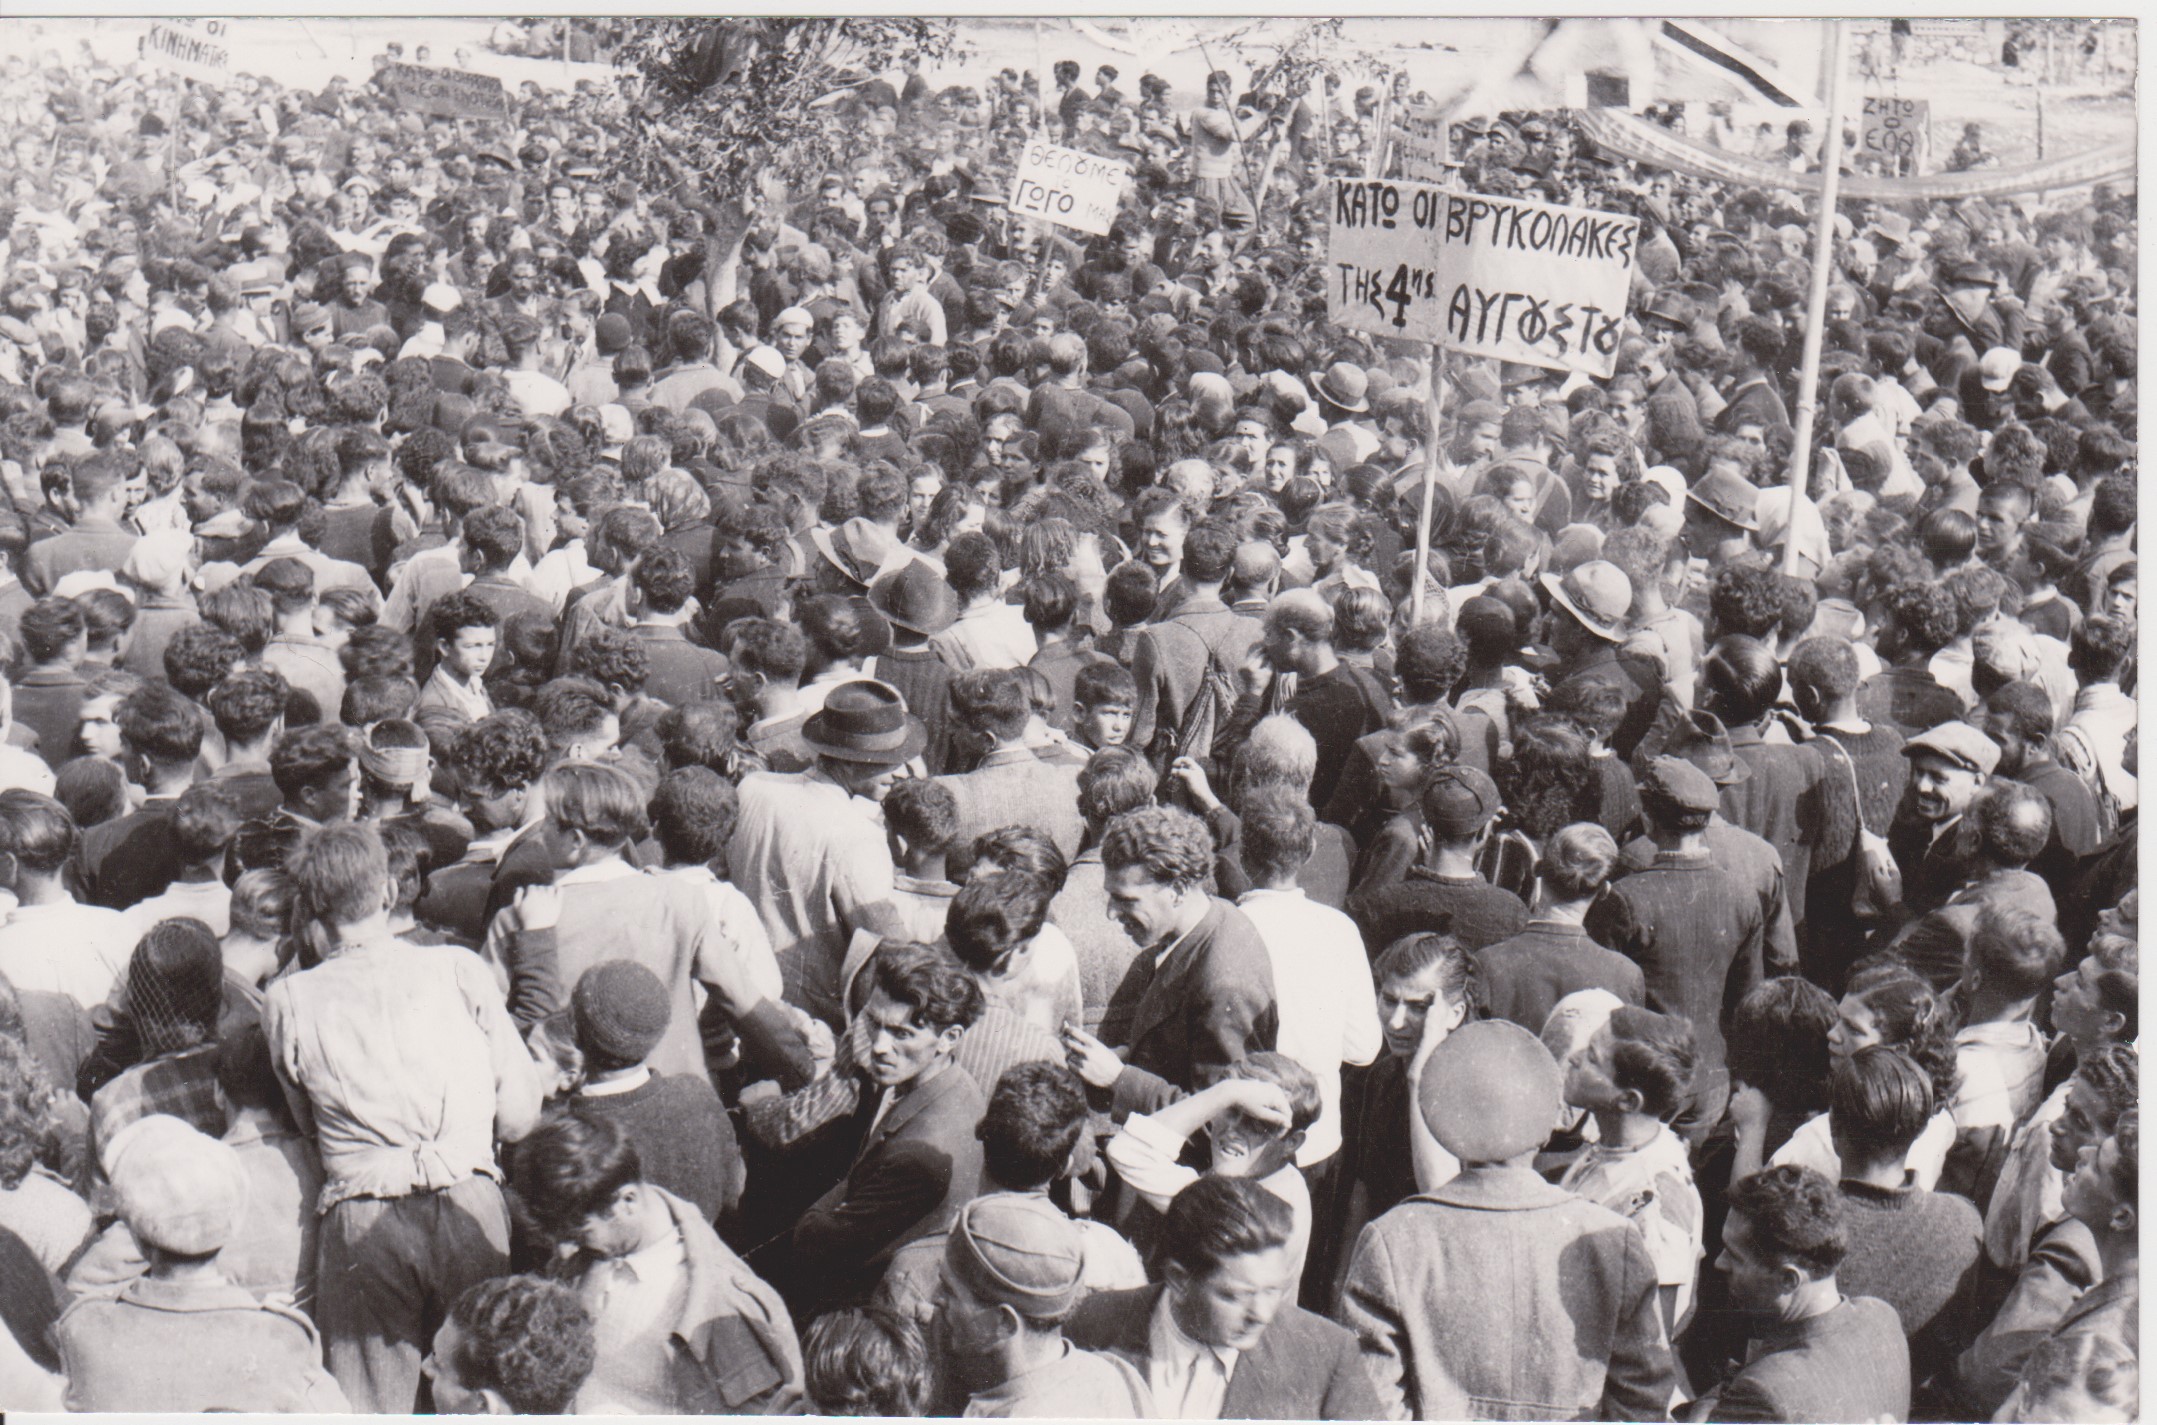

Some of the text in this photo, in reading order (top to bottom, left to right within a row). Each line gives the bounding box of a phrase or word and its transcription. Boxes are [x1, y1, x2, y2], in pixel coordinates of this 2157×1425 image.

[1863, 97, 1914, 117] ΖΗΤΩ
[1884, 117, 1901, 129] Ο
[1336, 179, 1636, 269] ΚΑΤΩ ΟΙ ΒΡΥΚΟΛΑΚΕΣ
